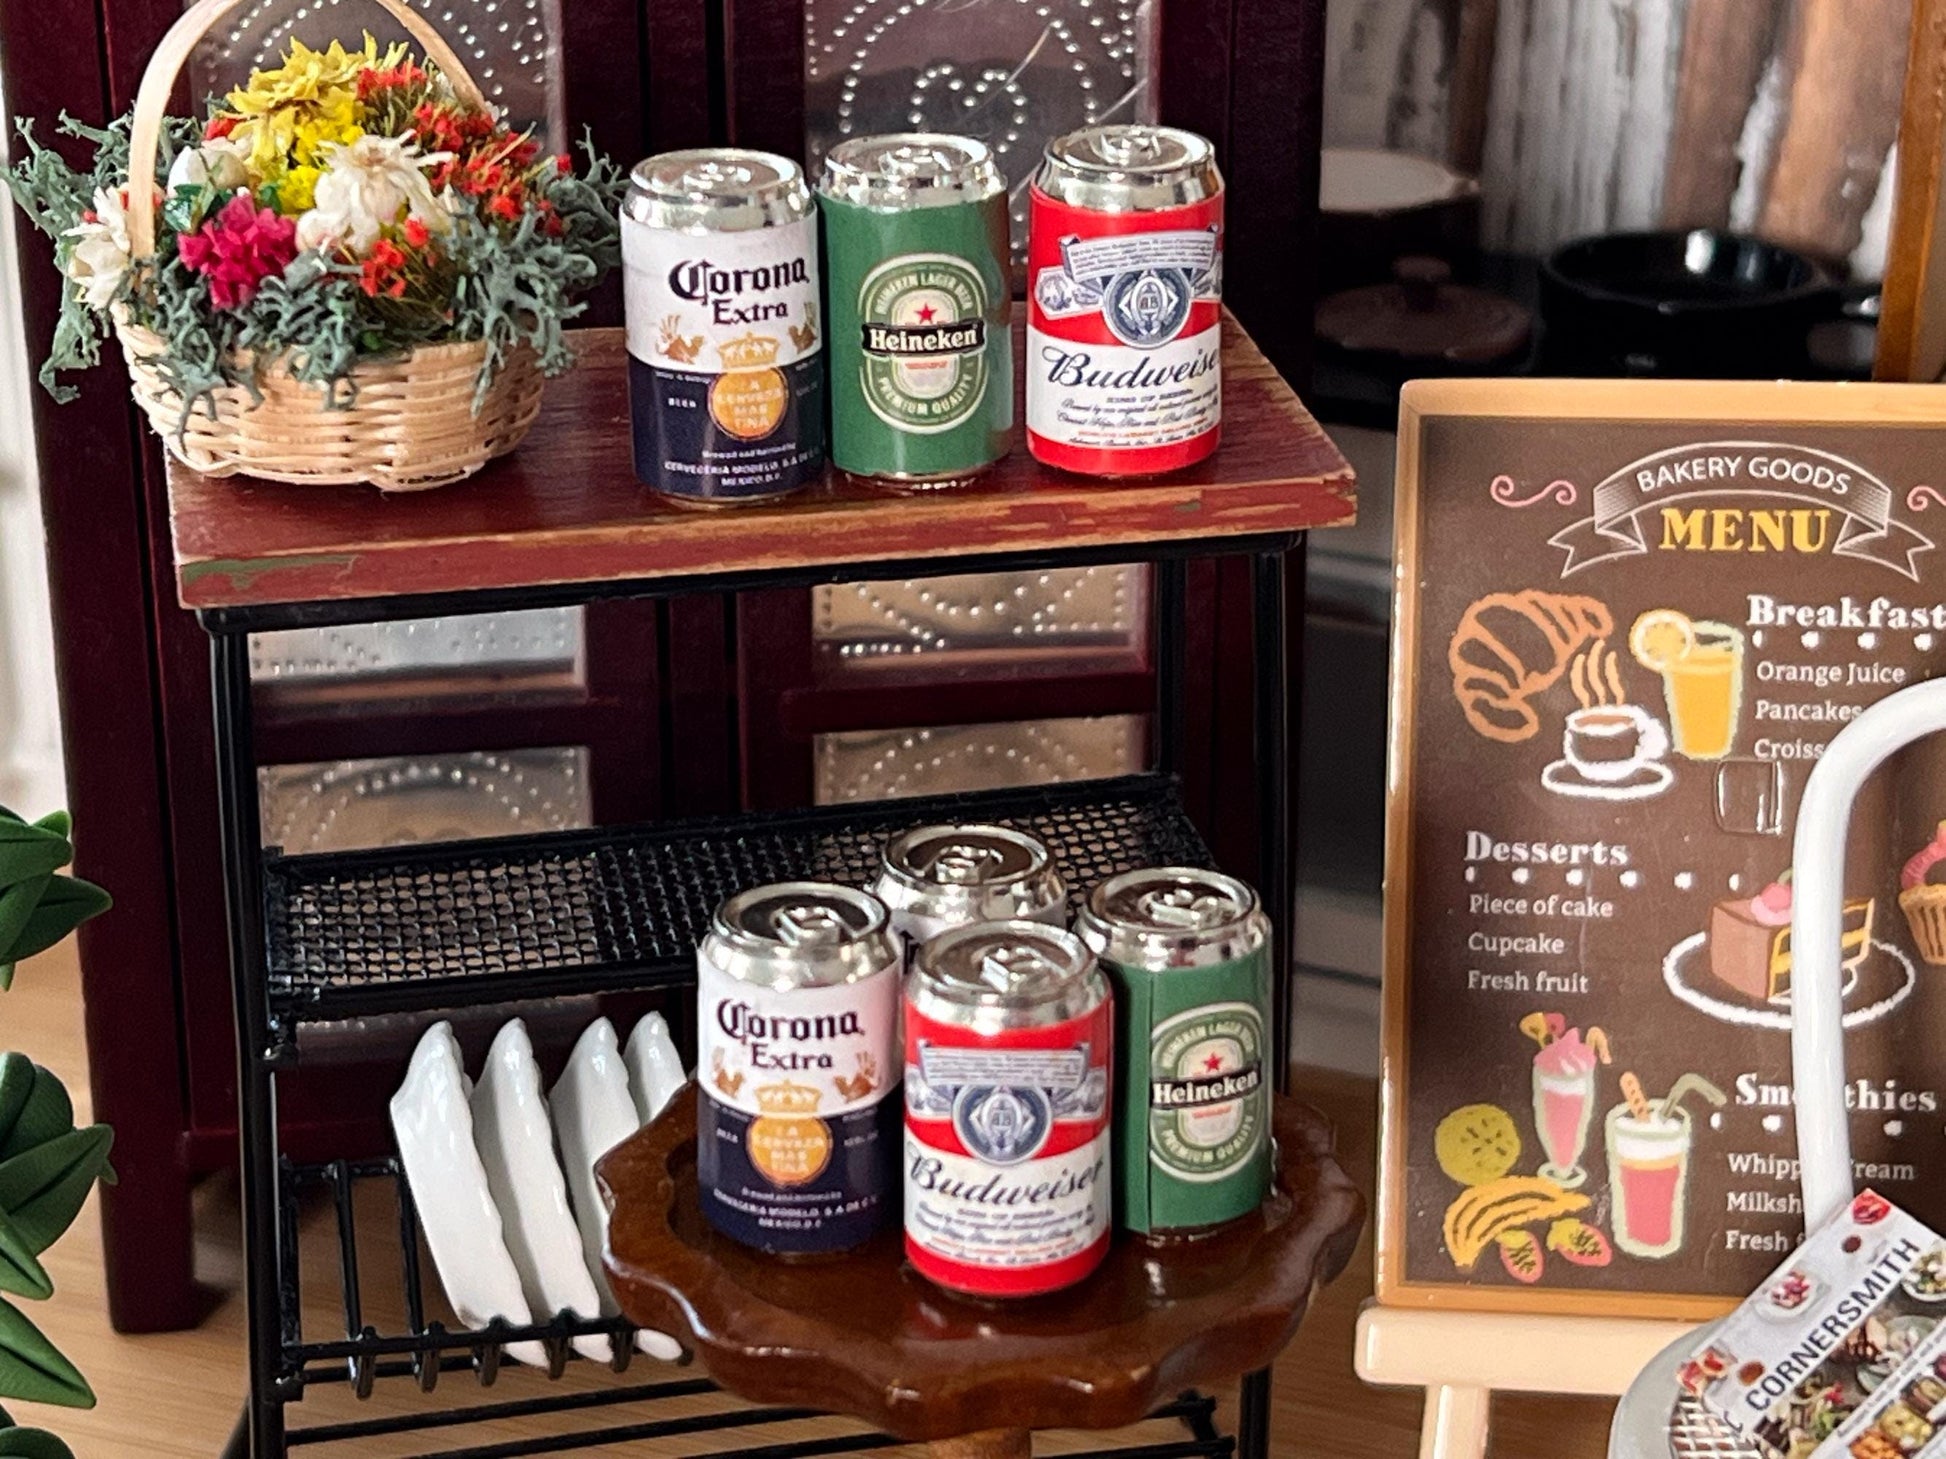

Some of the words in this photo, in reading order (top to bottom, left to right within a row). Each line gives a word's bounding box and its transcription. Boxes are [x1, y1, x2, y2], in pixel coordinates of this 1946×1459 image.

[668, 257, 810, 306] Corona
[712, 298, 788, 325] Extra
[869, 328, 978, 351] Heineken
[1042, 346, 1219, 389] Budweise
[1636, 456, 1742, 493] BAKERY
[1748, 456, 1852, 495] GOODS
[1658, 507, 1831, 553] MENU
[1746, 594, 1946, 630] Breakfast
[1757, 660, 1843, 688] Orange
[1846, 662, 1906, 686] Juice
[1754, 738, 1825, 759] Croiss
[1464, 830, 1629, 866] Desserts
[1469, 893, 1528, 915] Piece
[1532, 894, 1559, 916] of
[1561, 896, 1614, 918] cake
[1468, 931, 1565, 956] Cupcake
[1468, 970, 1530, 991] Fresh
[1535, 970, 1589, 993] fruit
[717, 998, 866, 1046] Corona
[751, 1043, 833, 1070] Extra
[1153, 1070, 1259, 1104] Heineken
[1735, 1072, 1937, 1113] Smthies
[907, 1141, 1104, 1205] Budweiser
[1728, 1152, 1801, 1181] Whipp
[1850, 1157, 1915, 1181] ream
[1726, 1191, 1804, 1214] Milksh
[1725, 1230, 1788, 1251] Fresh
[1744, 1236, 1920, 1412] CORNERSMITH
